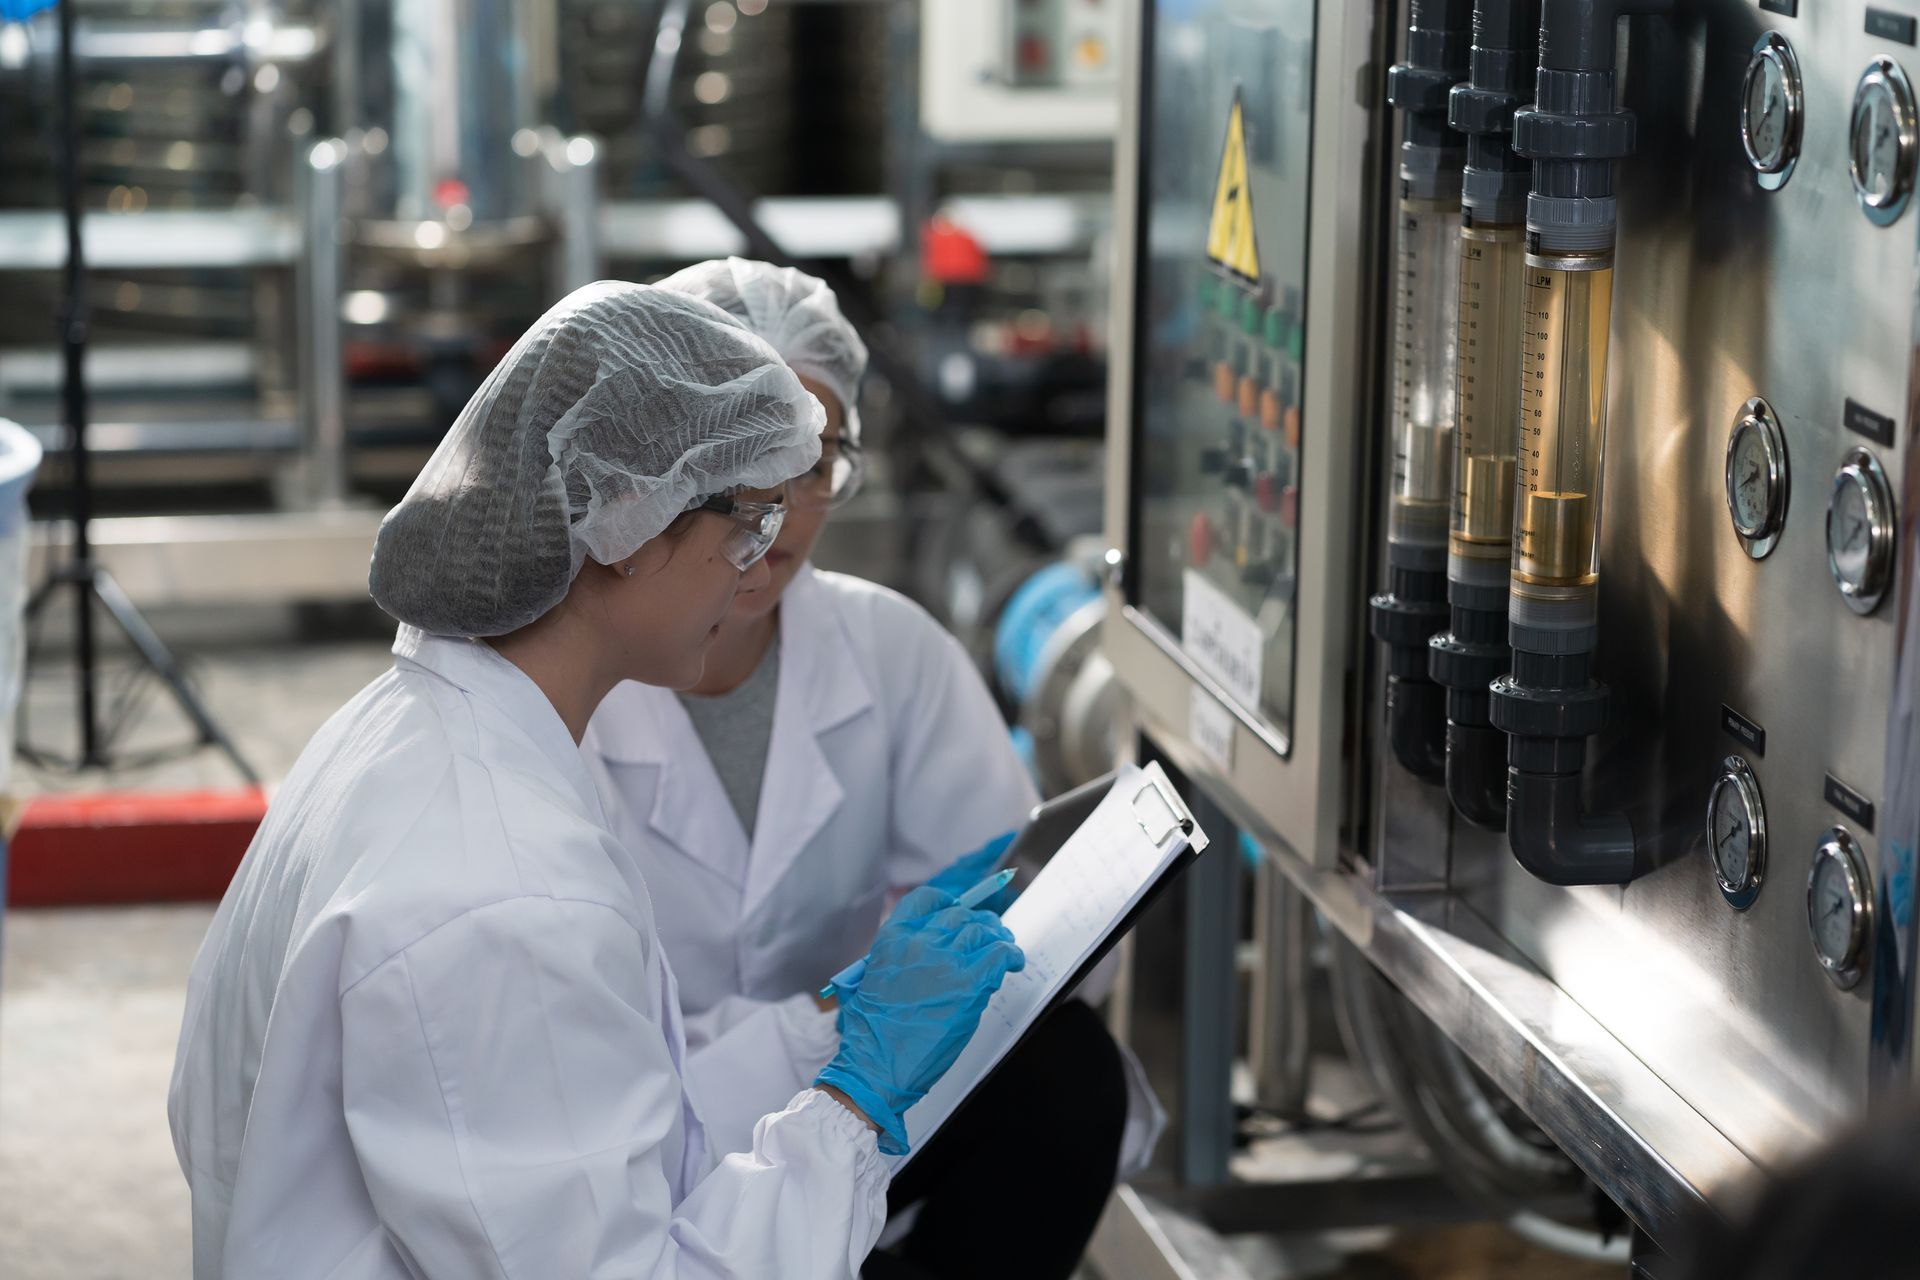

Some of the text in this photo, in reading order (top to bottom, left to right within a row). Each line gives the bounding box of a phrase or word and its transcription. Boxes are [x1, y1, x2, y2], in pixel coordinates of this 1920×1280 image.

[1536, 276, 1551, 286] LPM
[1538, 312, 1549, 320] 110
[1537, 332, 1548, 340] 100
[1537, 352, 1545, 361] 90
[1536, 371, 1544, 379] 80
[1535, 389, 1543, 397] 70
[1533, 428, 1540, 436] 50
[1532, 450, 1539, 458] 40
[1530, 484, 1538, 492] 20
